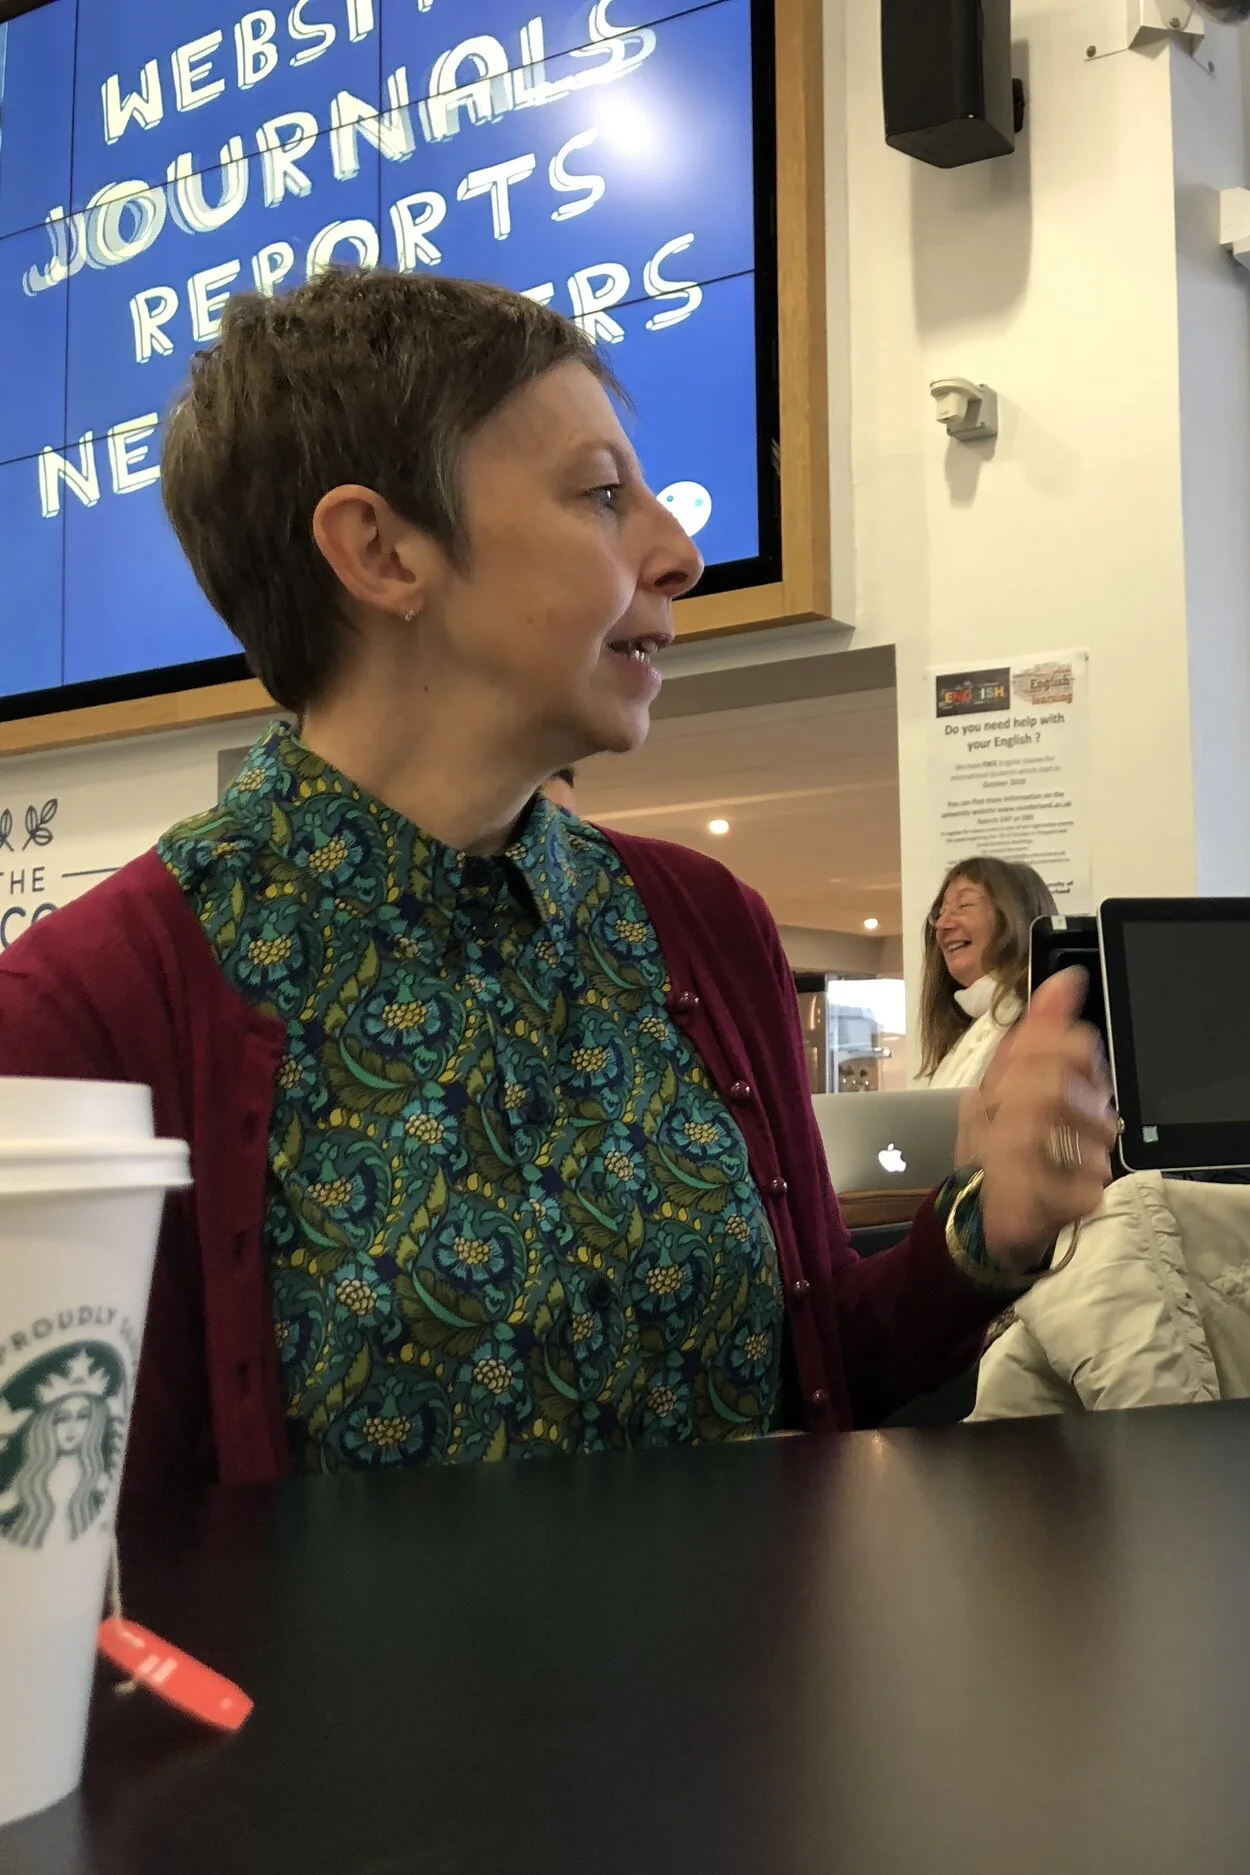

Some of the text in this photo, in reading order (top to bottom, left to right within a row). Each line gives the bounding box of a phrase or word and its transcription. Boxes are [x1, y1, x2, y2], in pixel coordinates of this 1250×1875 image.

[101, 0, 433, 145] WEBSI
[22, 2, 657, 297] JOURNALS
[130, 128, 606, 364] REPORTS
[1030, 674, 1071, 690] English
[945, 712, 1065, 735] Do you need help with
[967, 732, 1041, 752] your English ?
[0, 866, 45, 895] HE
